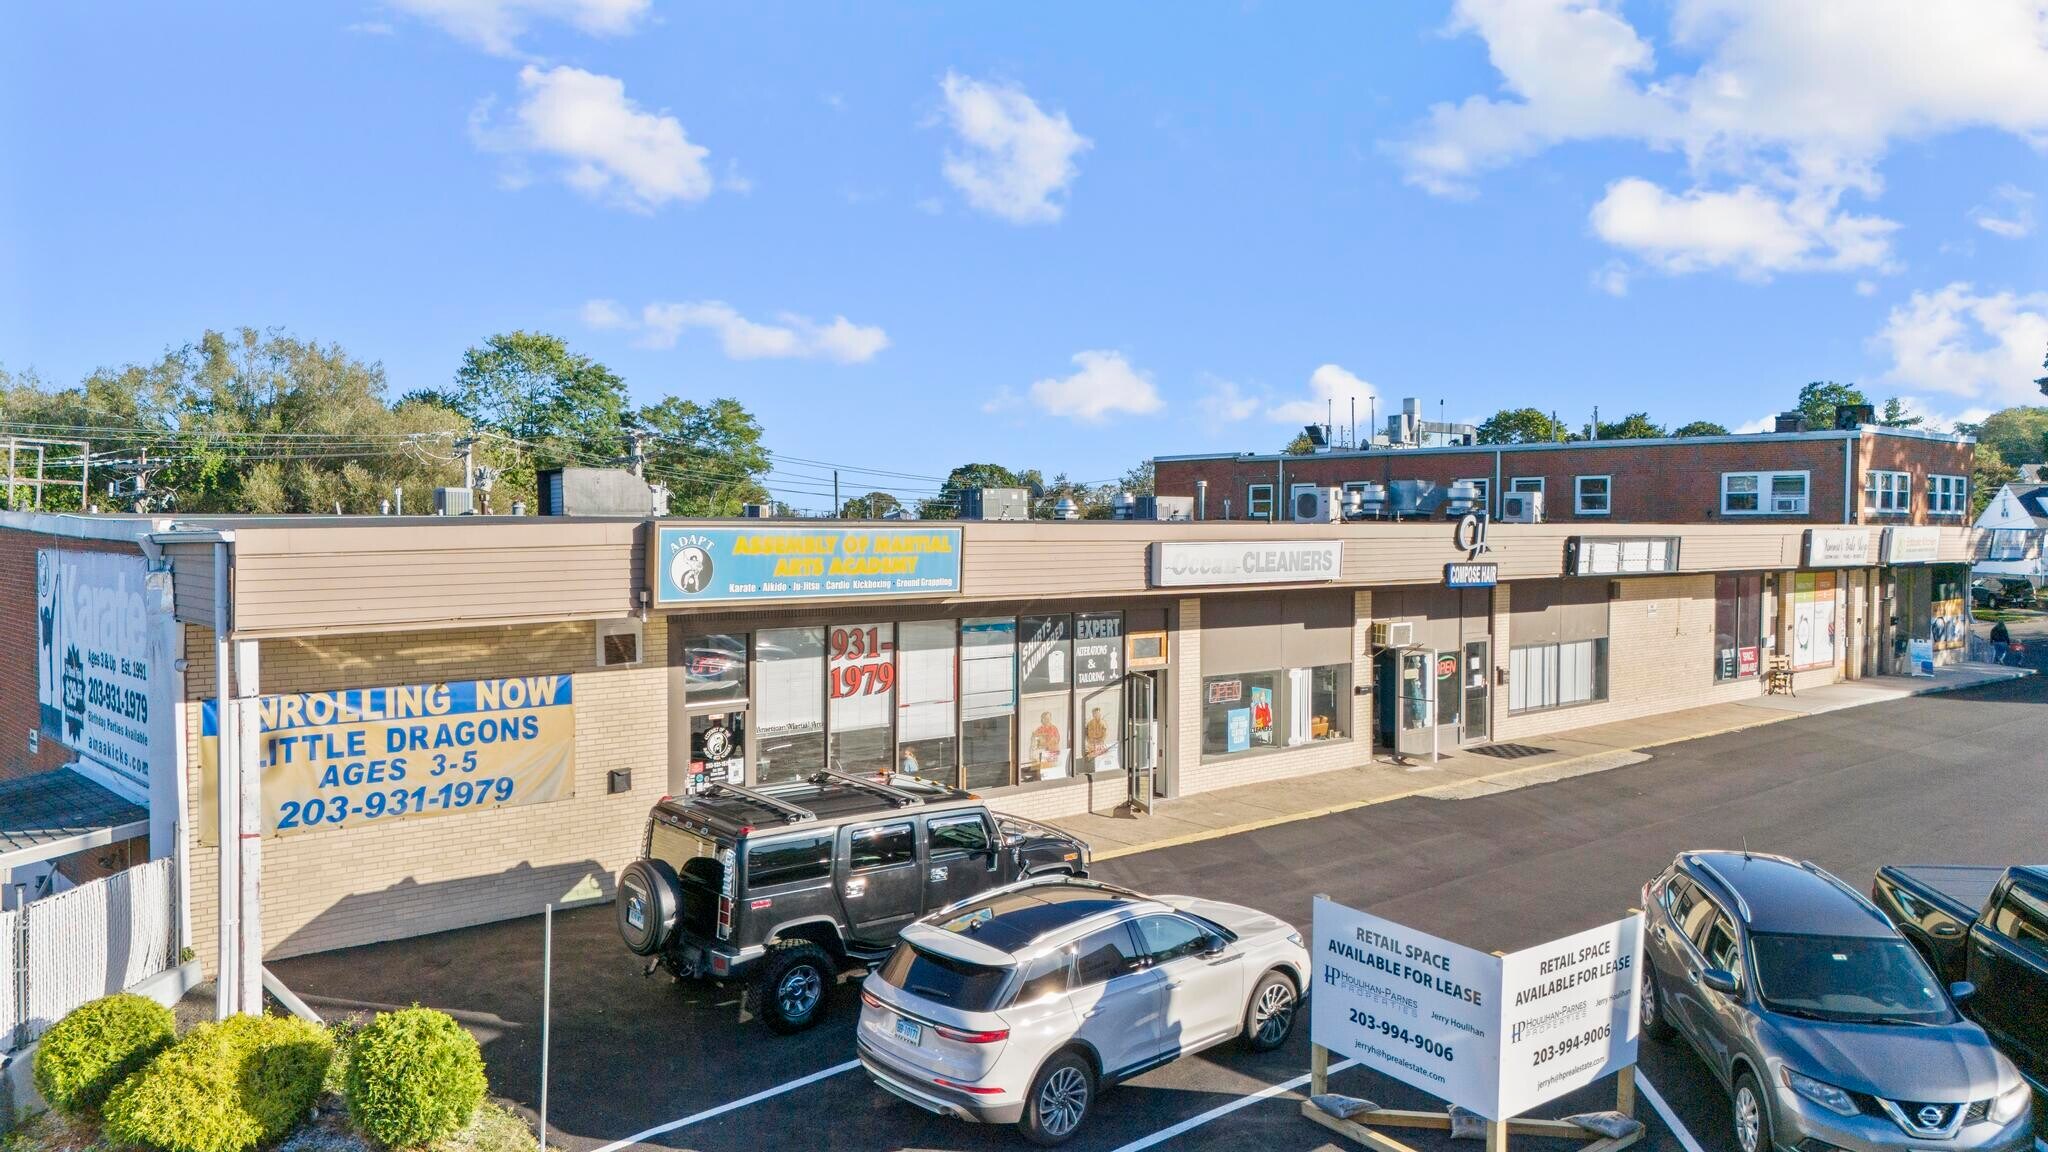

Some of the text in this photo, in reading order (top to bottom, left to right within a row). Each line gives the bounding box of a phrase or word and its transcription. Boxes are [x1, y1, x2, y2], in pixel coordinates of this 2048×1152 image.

[670, 534, 715, 553] ADAPT
[732, 535, 952, 555] ASSEMBLY OF MARTIAL
[1243, 550, 1333, 573] CLEANERS
[773, 556, 918, 576] ARTS ACADEMY
[1451, 566, 1497, 583] COMPOSE HAIR
[729, 577, 952, 593] Karate Aikido Ju-Jitsu Cardio Kickboxing Ground Grappling
[61, 563, 147, 660] Karate
[1077, 618, 1120, 638] EXPERT
[831, 627, 893, 661] 931-
[1022, 617, 1051, 662] SHIRTS
[1022, 622, 1064, 681] LAUNDERED
[1076, 645, 1108, 656] ALTERATIONS
[88, 649, 99, 668] Ages
[100, 652, 104, 668] 3
[110, 655, 116, 674] Up
[121, 658, 132, 677] Est.
[133, 661, 147, 680] 1991
[830, 661, 895, 699] 1979
[1078, 671, 1105, 683] TAILORING
[1087, 659, 1096, 669] &
[88, 677, 148, 724] 203-931-1979
[259, 676, 557, 732] NROLLING NOW
[88, 710, 106, 731] Birthday
[107, 718, 124, 737] Parties
[125, 726, 148, 746] Available
[259, 715, 539, 768] ITTLE DRAGONS
[88, 737, 149, 776] amaakicks.com
[319, 750, 478, 788] AGES 3-5
[277, 776, 515, 829] 203-931-1979
[1356, 927, 1450, 971] RETAIL SPACE
[1540, 940, 1611, 976] RETAIL SPACE
[1328, 939, 1482, 1006] AVAILABLE FOR LEASE
[1515, 955, 1631, 1007] AVAILABLE FOR LEASE
[1595, 997, 1608, 1007] Jerry
[1349, 1008, 1454, 1062] 203-994-9006
[1431, 1011, 1485, 1038] Jerry Houlihan
[1354, 1039, 1446, 1084] jerryh@hprealestate.com
[1532, 1023, 1611, 1067] 203-994-9006
